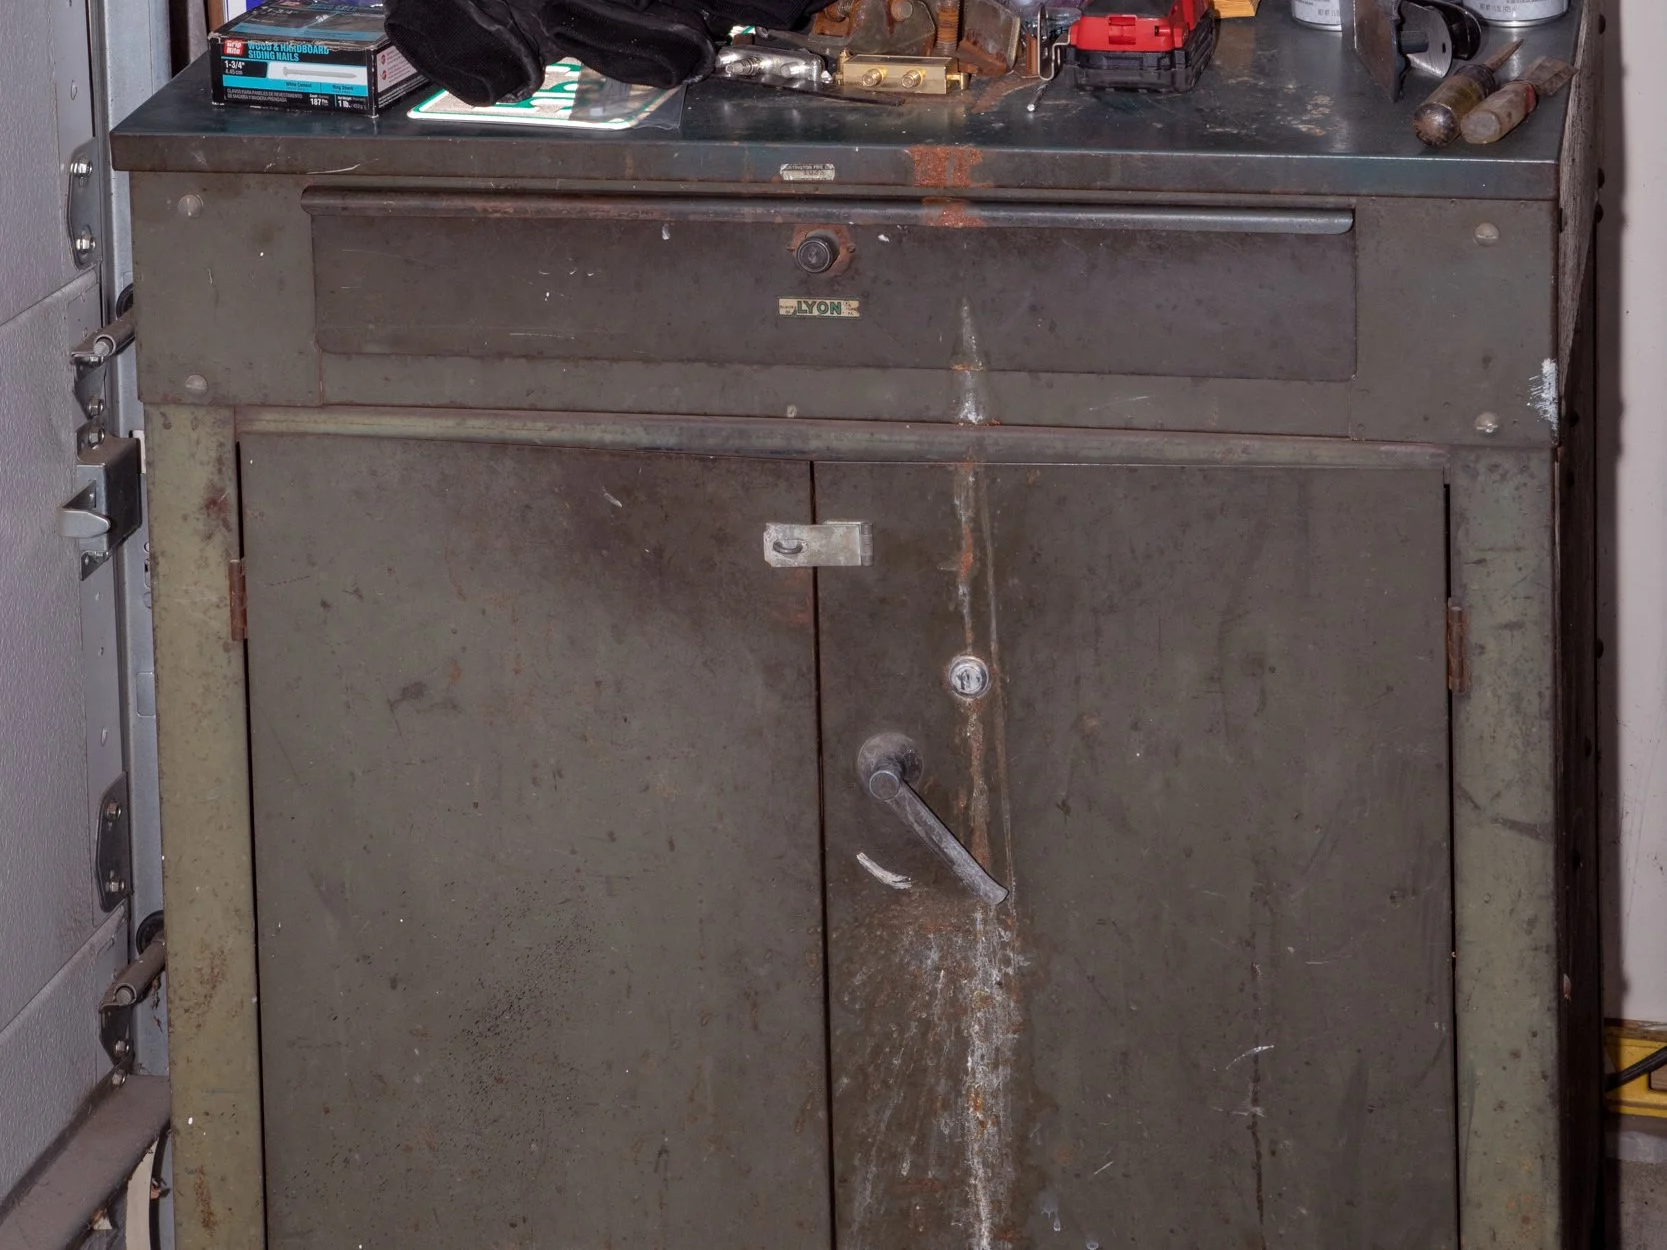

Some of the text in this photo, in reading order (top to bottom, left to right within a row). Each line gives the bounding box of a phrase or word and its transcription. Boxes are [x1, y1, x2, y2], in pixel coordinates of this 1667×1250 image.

[247, 41, 329, 54] WOOD & HARDBOARD
[248, 50, 299, 61] SIDING NAILS
[310, 98, 321, 106] 187
[796, 300, 842, 315] LYON
